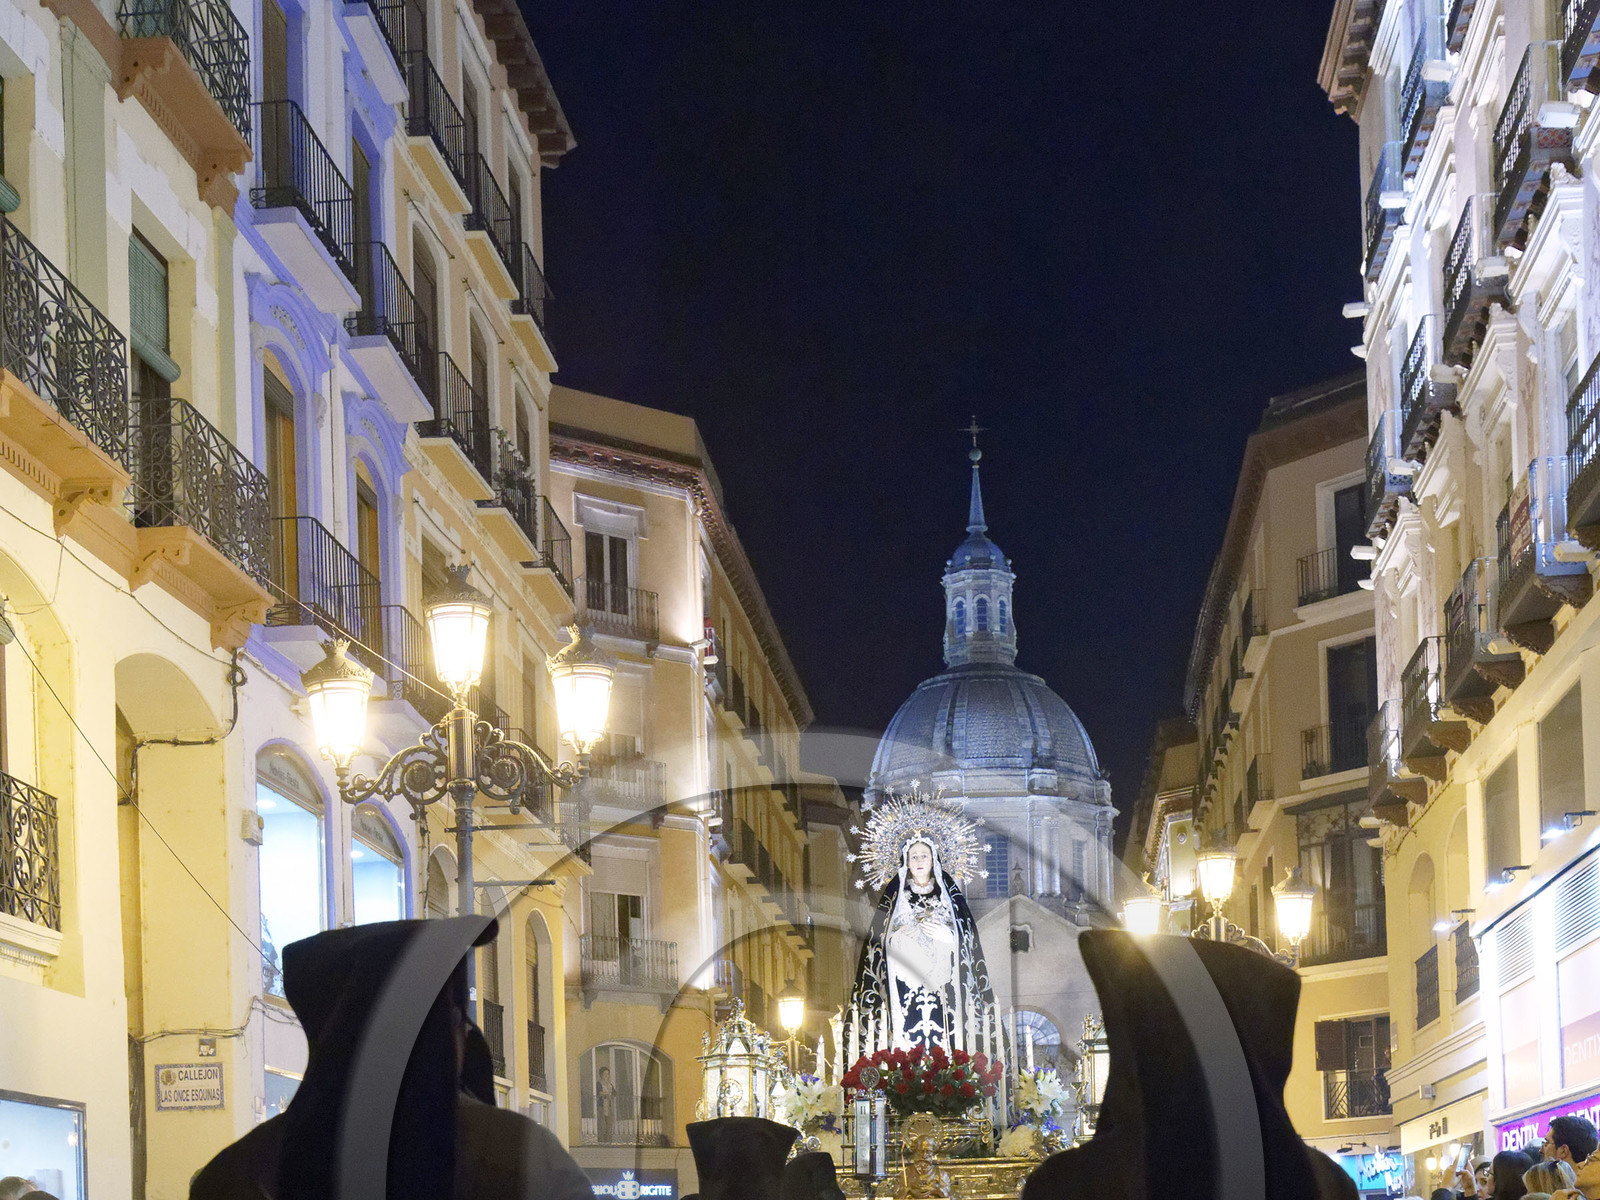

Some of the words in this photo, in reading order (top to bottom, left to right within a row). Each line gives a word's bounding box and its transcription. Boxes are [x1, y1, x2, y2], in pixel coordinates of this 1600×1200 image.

[178, 1069, 218, 1080] CALLEJON
[161, 1089, 172, 1103] LAS
[174, 1089, 190, 1102] ONCE
[191, 1088, 220, 1102] ESQUINAS
[1502, 1122, 1539, 1151] DENTIX
